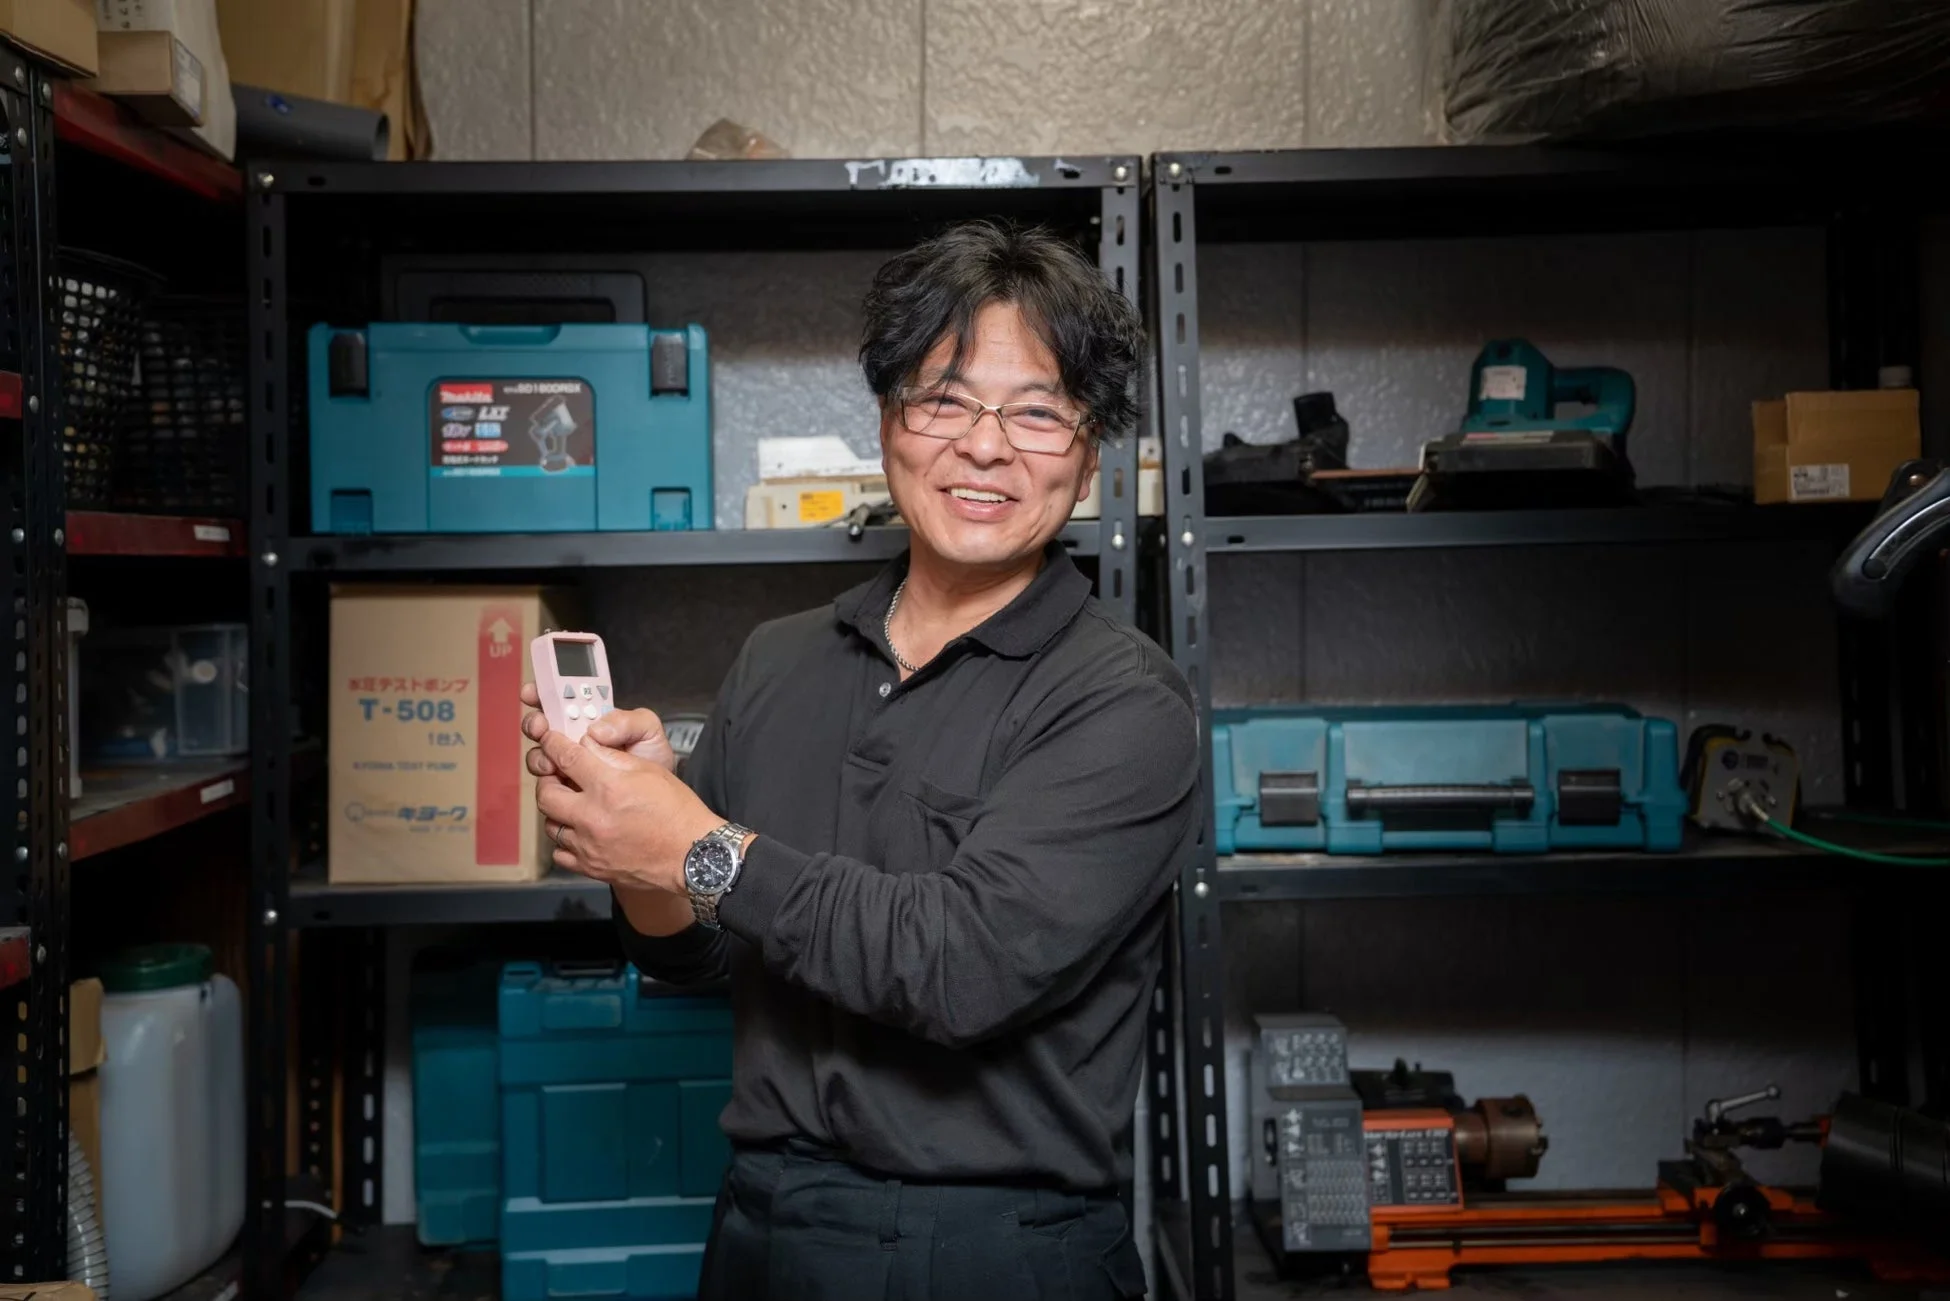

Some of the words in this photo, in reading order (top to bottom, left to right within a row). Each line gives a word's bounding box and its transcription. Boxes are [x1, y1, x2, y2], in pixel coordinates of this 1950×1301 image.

[489, 643, 513, 658] UP
[358, 698, 456, 722] T-508
[427, 731, 466, 746] 1台入
